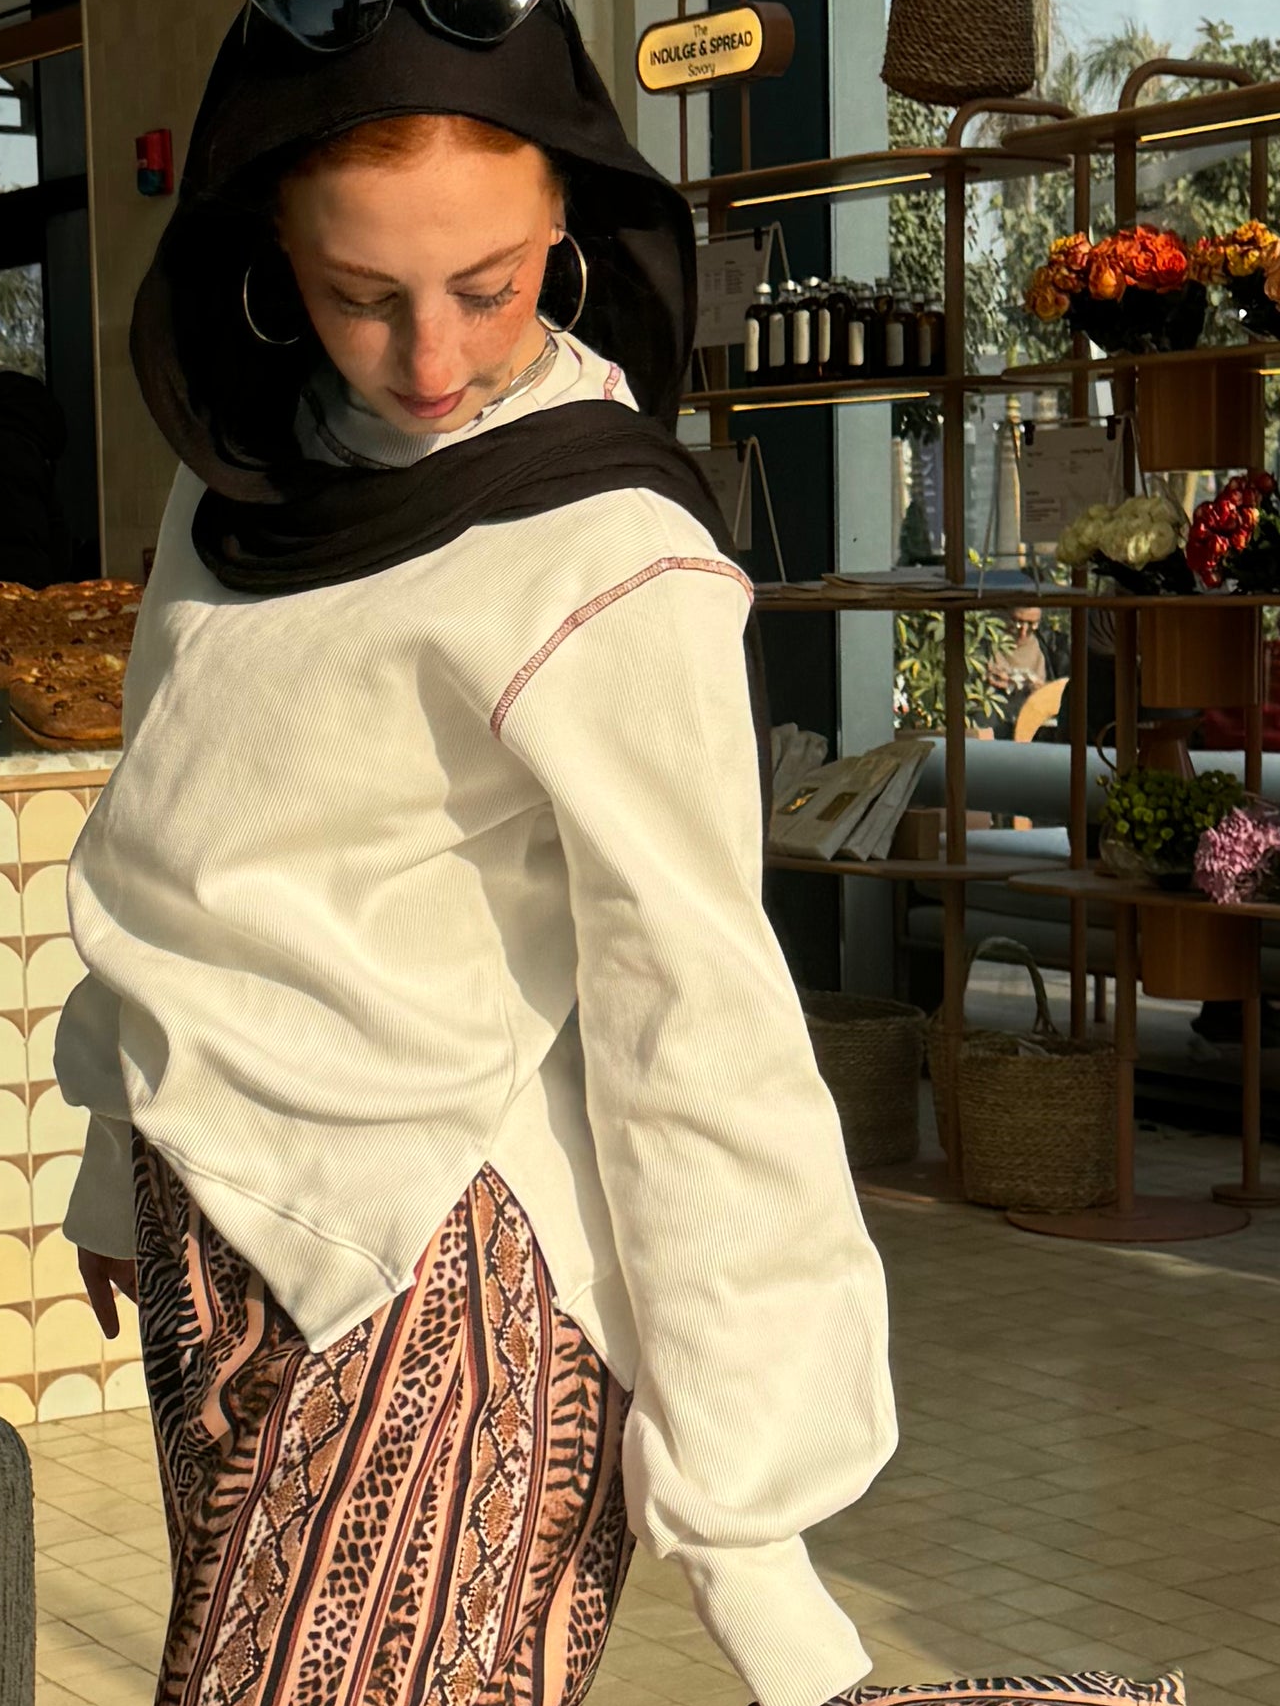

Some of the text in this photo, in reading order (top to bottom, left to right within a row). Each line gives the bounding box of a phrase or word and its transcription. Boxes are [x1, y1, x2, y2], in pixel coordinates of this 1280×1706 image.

[693, 24, 708, 38] The
[650, 30, 753, 66] INDULGE & SPREAD
